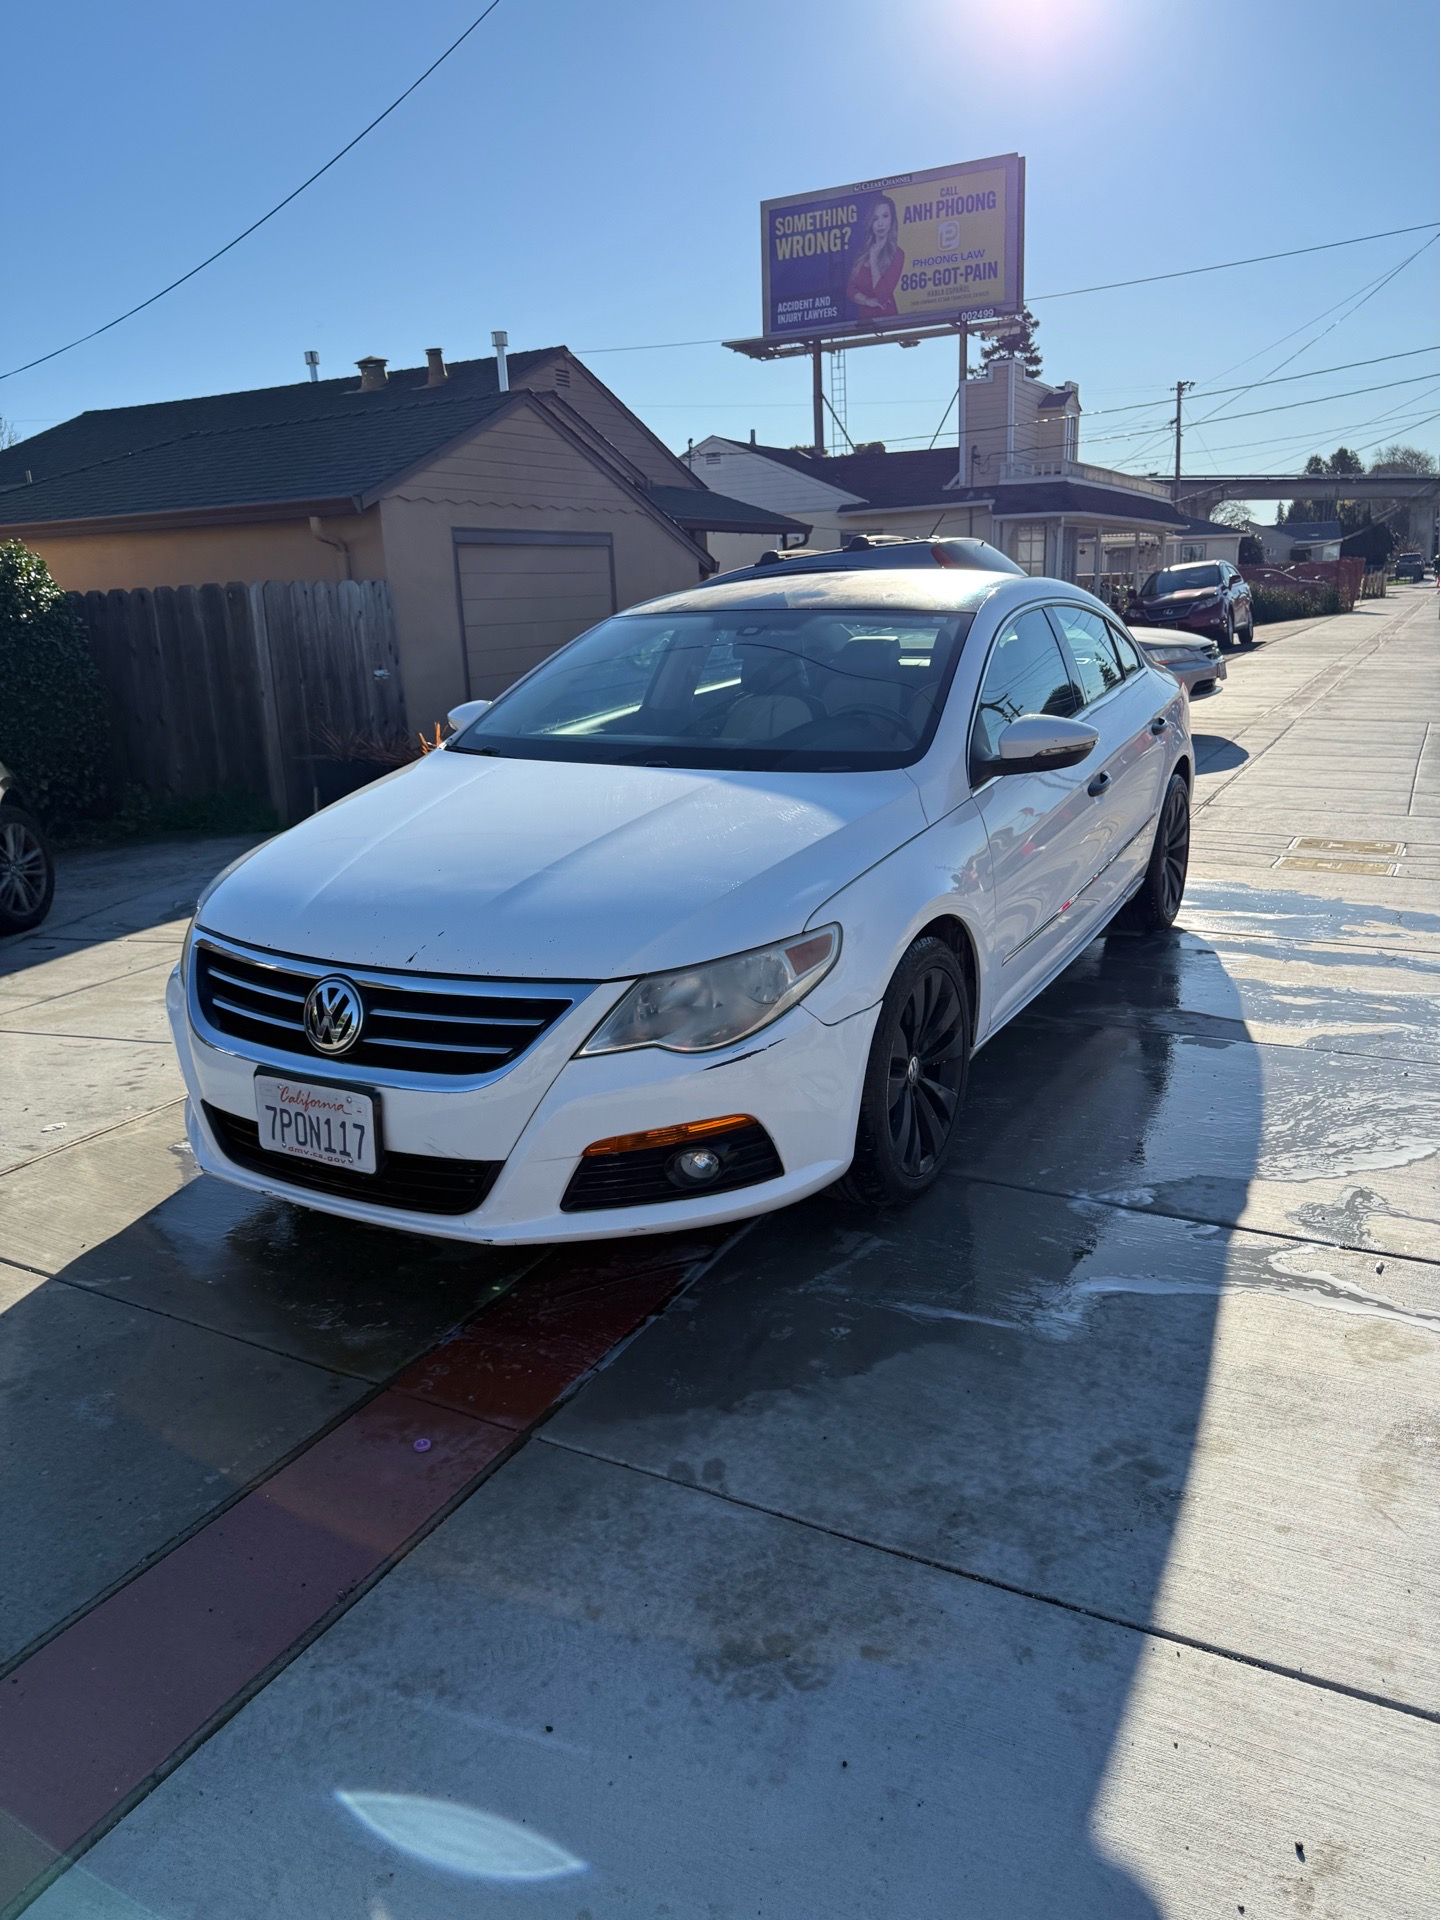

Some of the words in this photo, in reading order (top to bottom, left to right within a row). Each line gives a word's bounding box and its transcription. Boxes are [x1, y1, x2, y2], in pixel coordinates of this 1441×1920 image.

[903, 202, 933, 224] ANH
[936, 190, 997, 218] PHOONG
[940, 186, 959, 198] CALL
[775, 204, 857, 235] SOMETHING
[775, 227, 852, 260] WRONG?
[912, 253, 958, 268] PHOONG
[960, 249, 986, 261] LAW
[901, 261, 998, 292] 866-GOT-PAIN
[777, 298, 813, 313] ACCIDENT
[815, 296, 831, 307] AND
[777, 311, 802, 324] INJURY
[804, 306, 838, 321] LAWYERS
[961, 308, 994, 322] 002499
[279, 1085, 352, 1115] California
[265, 1105, 366, 1160] 7PON117
